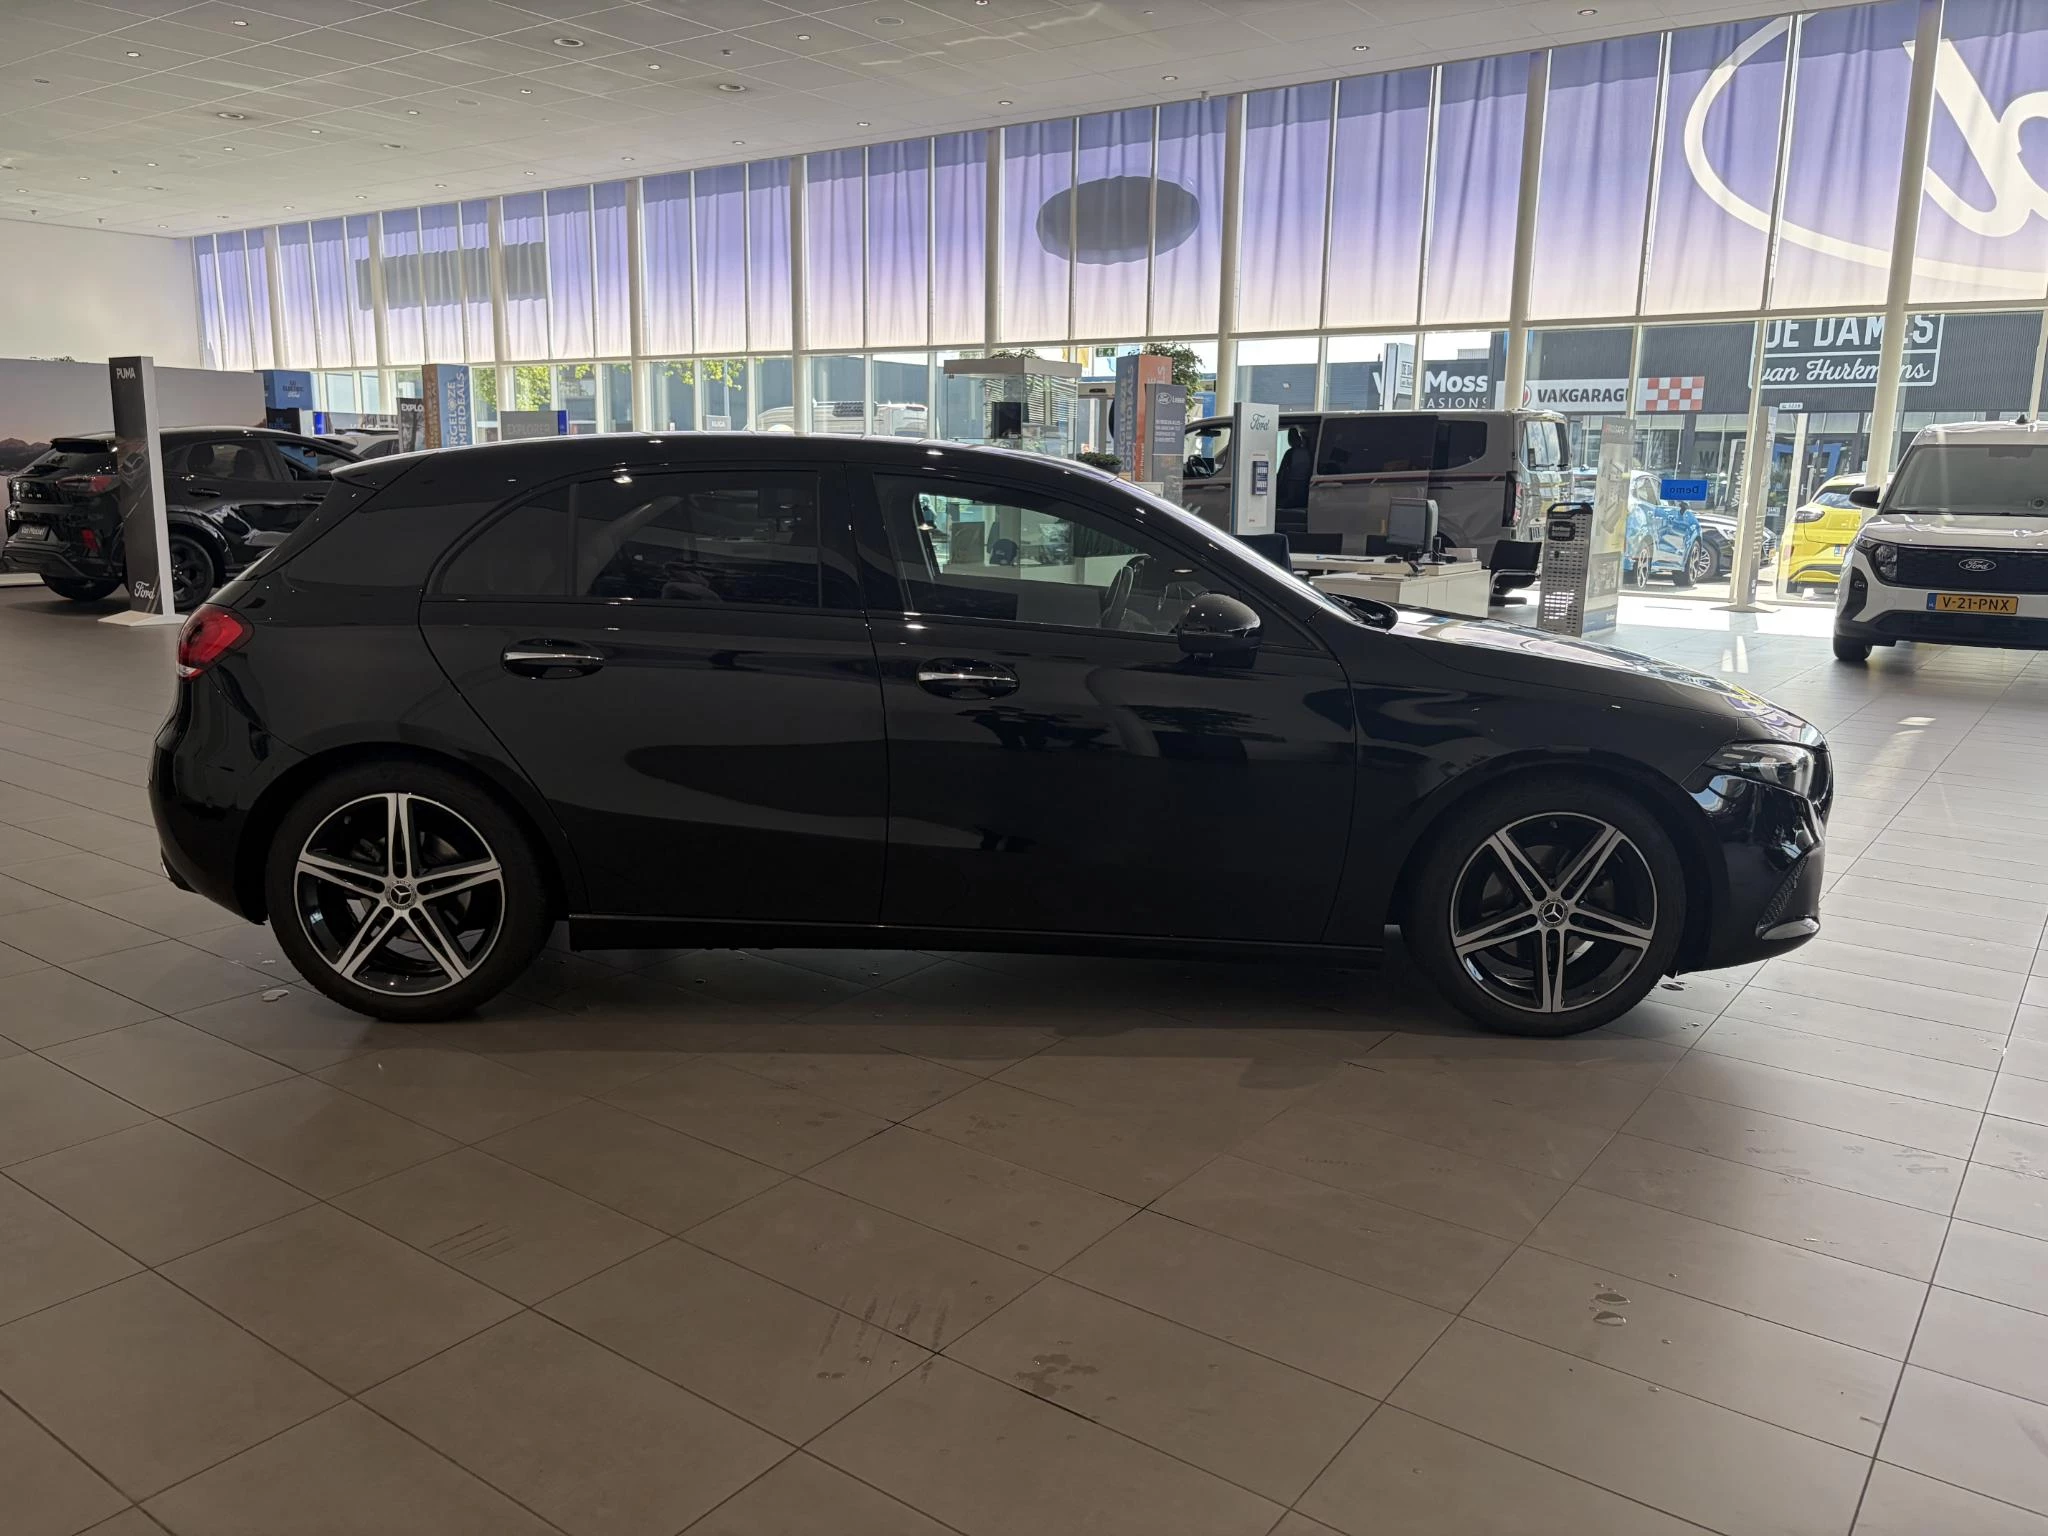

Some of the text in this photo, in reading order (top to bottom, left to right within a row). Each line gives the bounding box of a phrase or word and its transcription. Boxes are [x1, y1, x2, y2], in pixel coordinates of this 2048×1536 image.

[1814, 314, 1934, 347] DAMS
[116, 367, 136, 380] PUMA
[1806, 357, 1930, 382] Hurkmns
[1424, 370, 1489, 394] Moss
[1250, 413, 1270, 431] Ford
[1964, 560, 1991, 571] Ford
[134, 580, 156, 600] Ford
[1942, 596, 2009, 611] V-21-PNX
